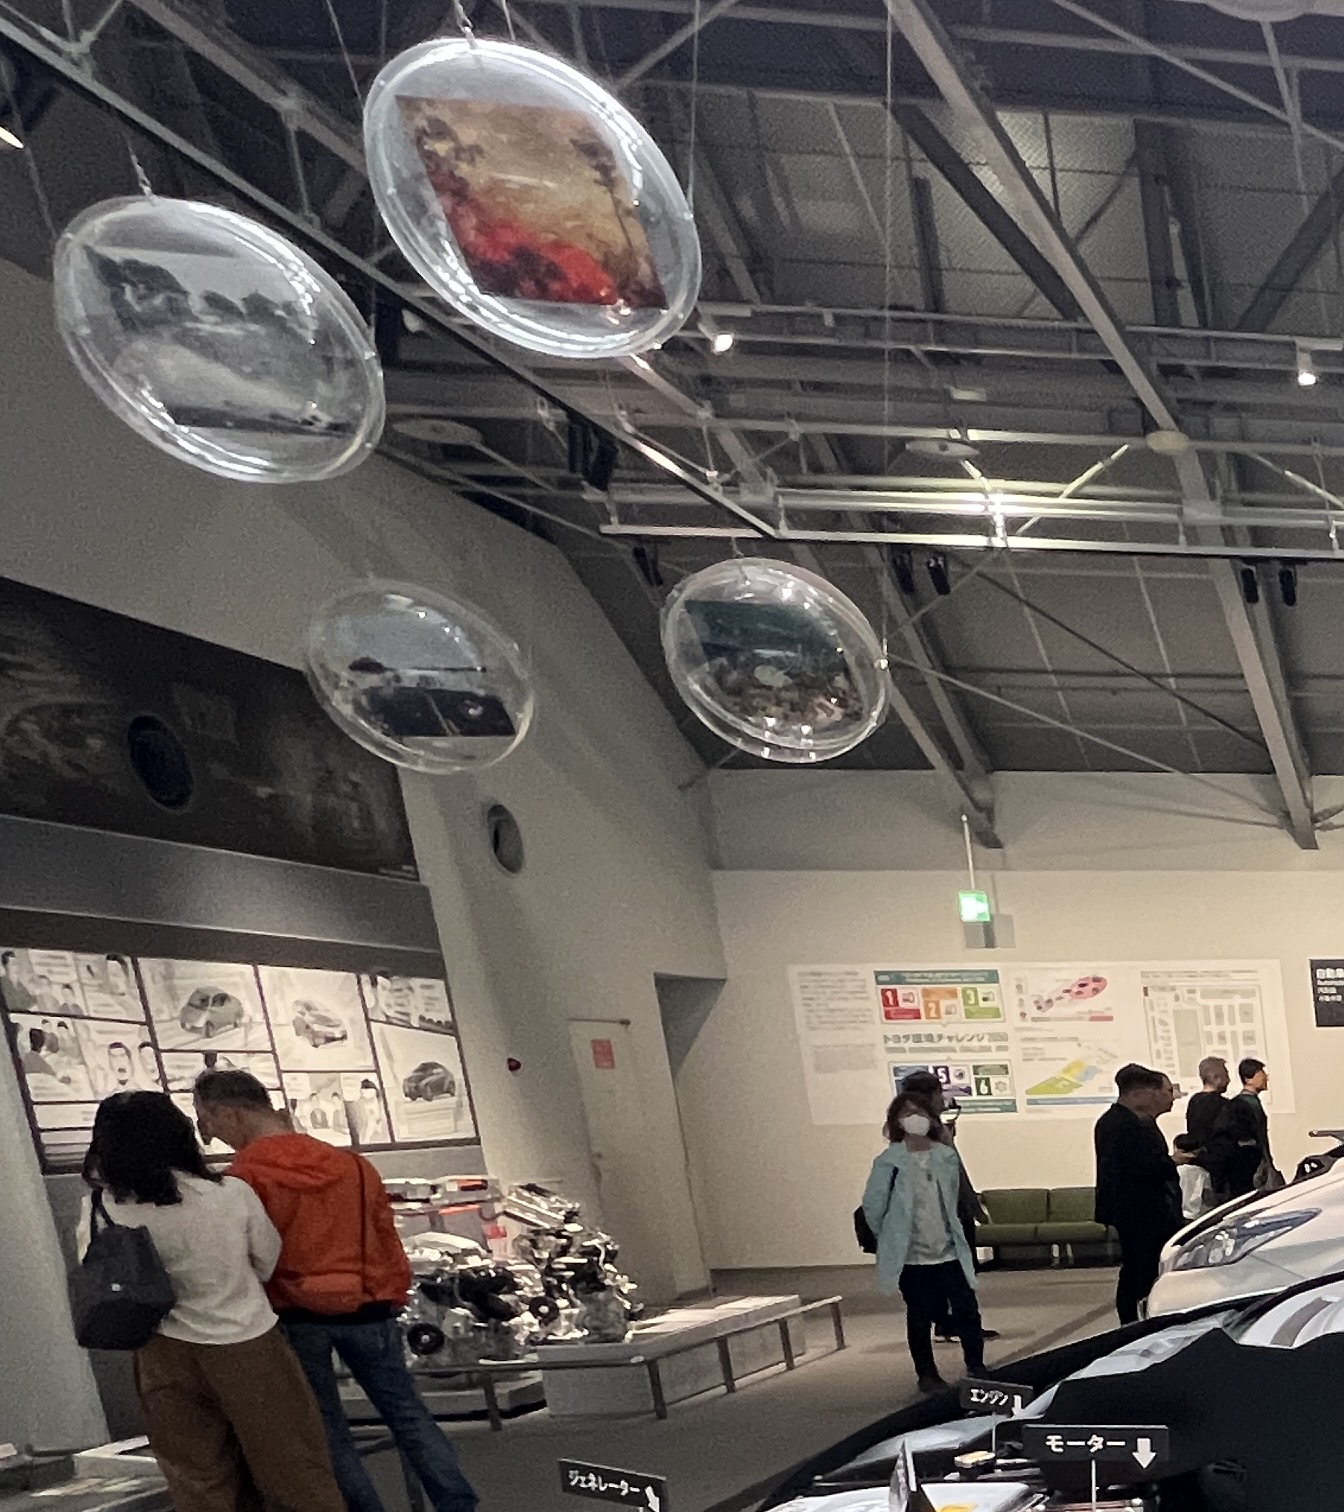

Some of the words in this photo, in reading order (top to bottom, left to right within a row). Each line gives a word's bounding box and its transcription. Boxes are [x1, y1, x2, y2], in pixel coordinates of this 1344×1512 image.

[1045, 1434, 1126, 1453] モーター
[568, 1470, 640, 1496] ジェネレーター
